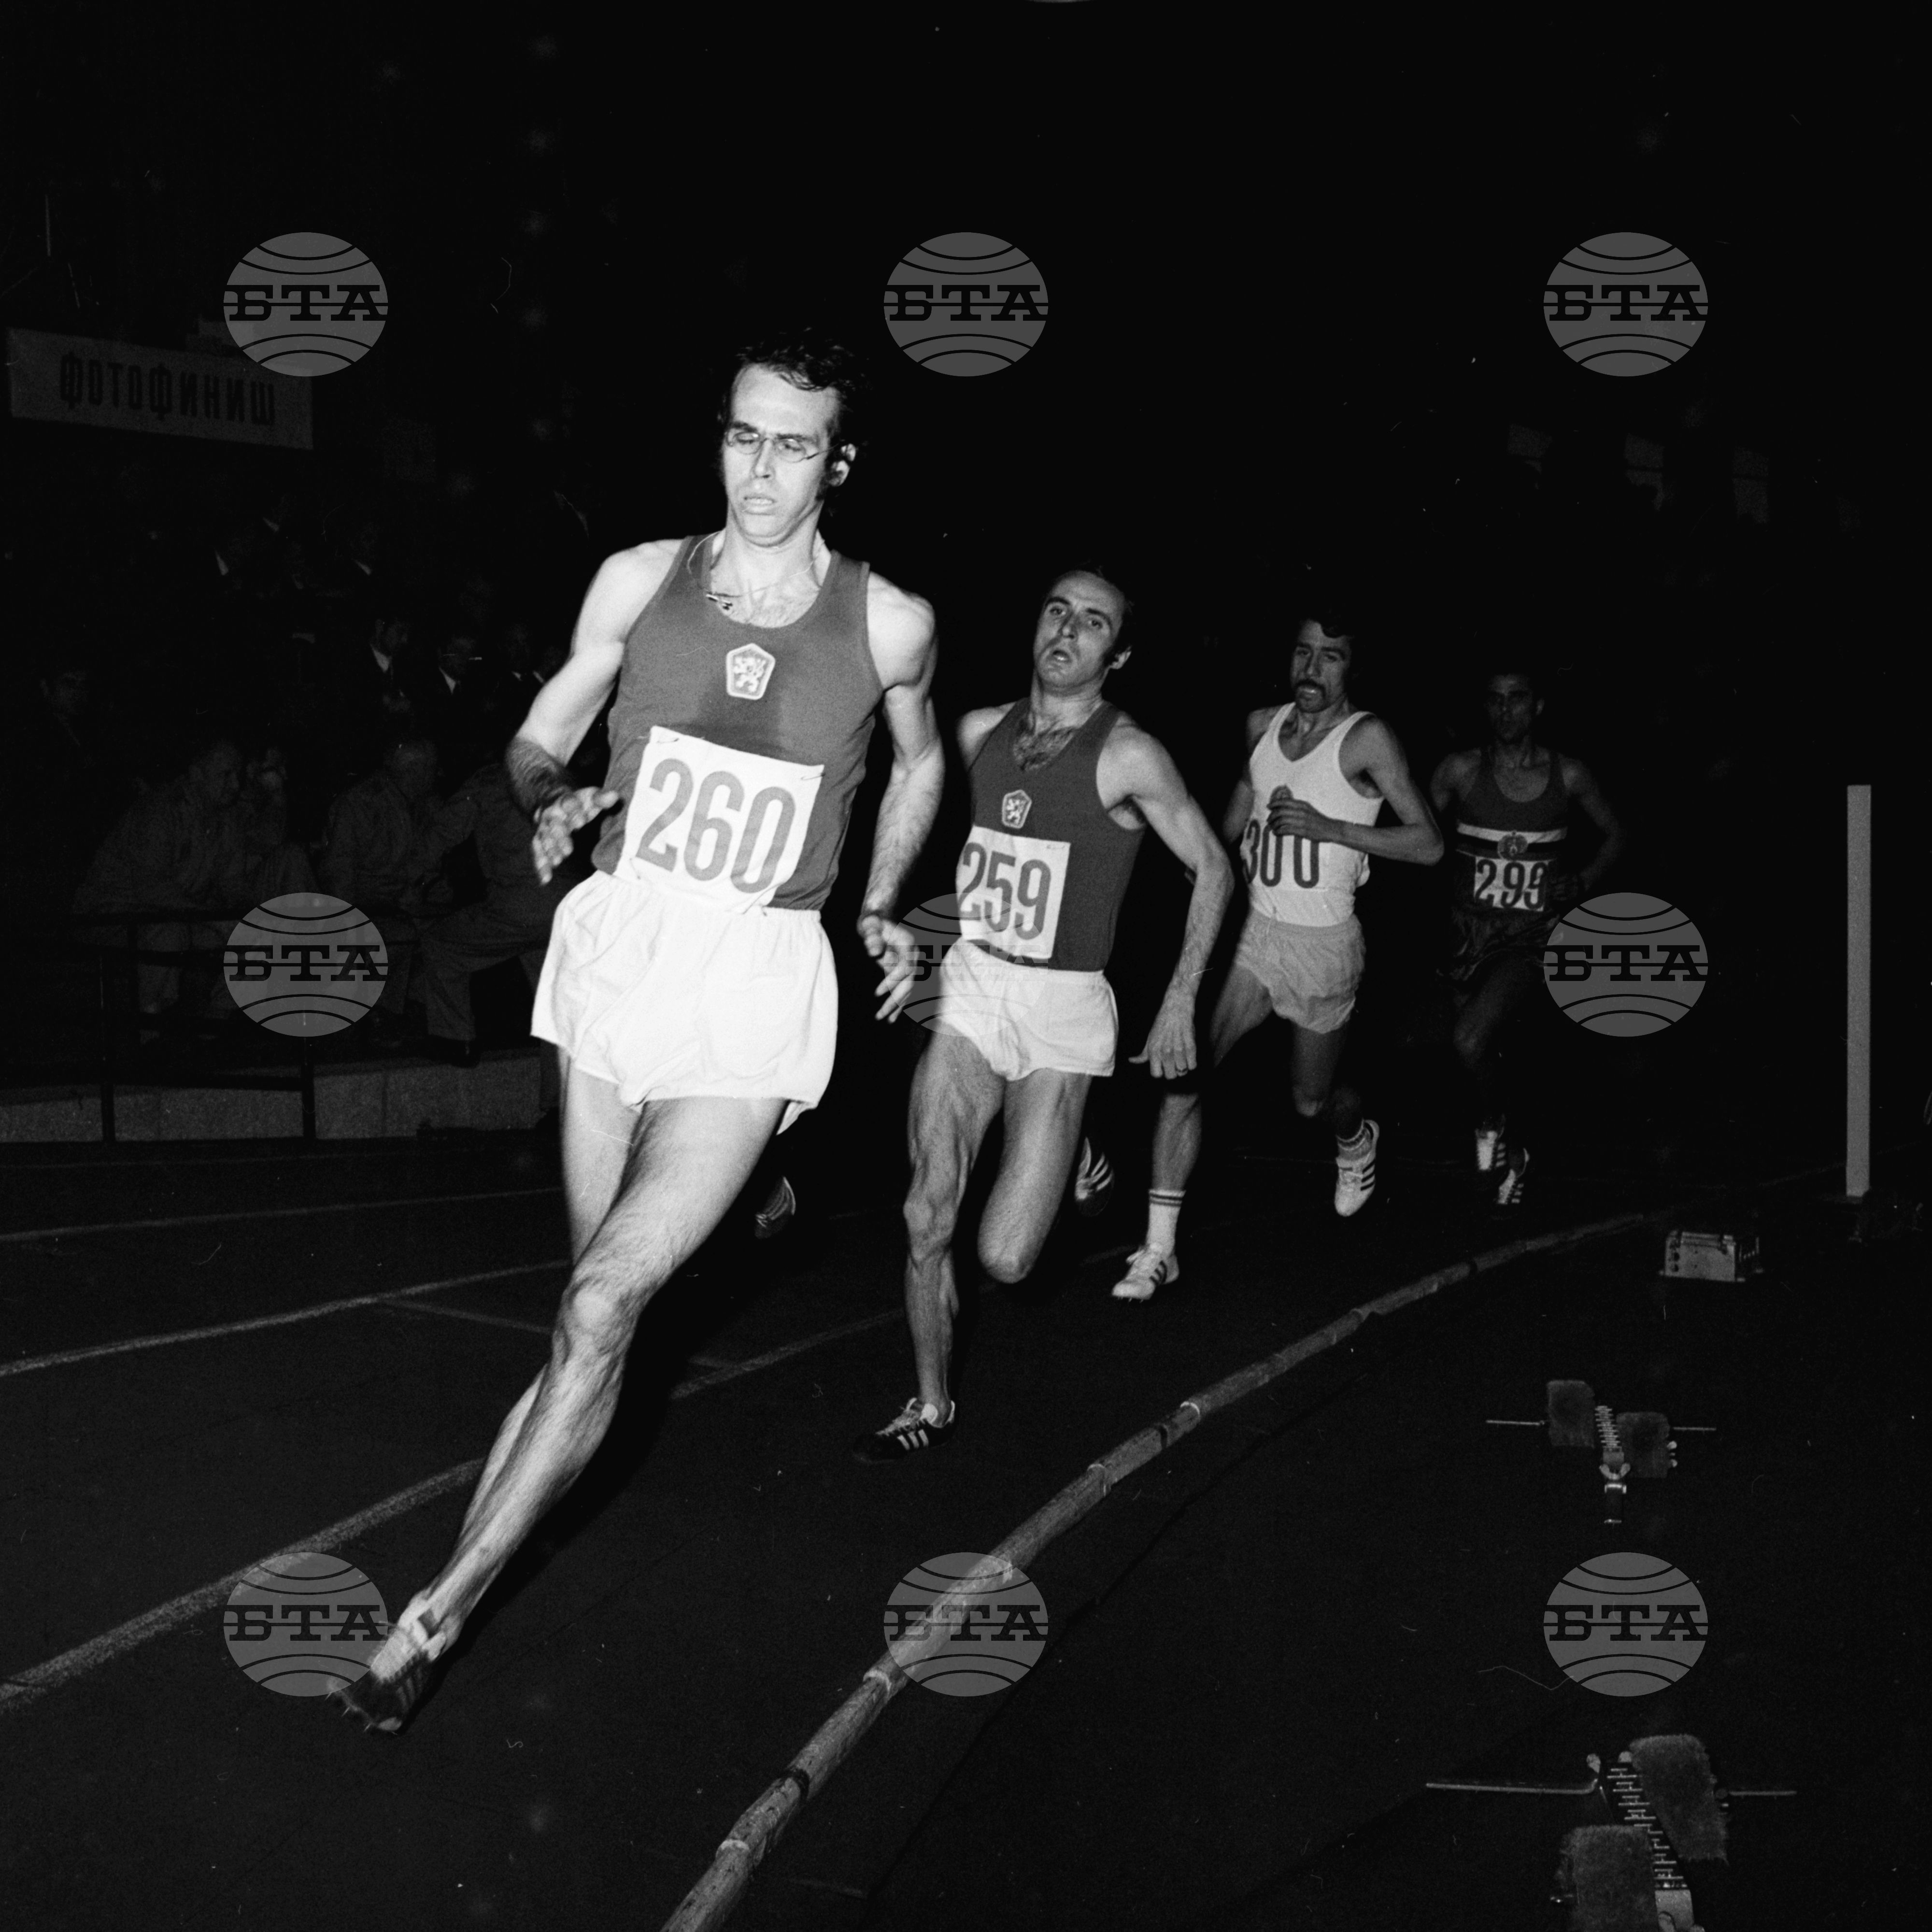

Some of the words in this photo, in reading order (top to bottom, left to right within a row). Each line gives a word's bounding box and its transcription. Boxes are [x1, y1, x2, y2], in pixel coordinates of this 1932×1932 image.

[60, 351, 275, 426] ФОТОФИНИШ
[635, 758, 796, 894] 260
[959, 842, 1051, 940] 259
[1475, 859, 1547, 910] 299
